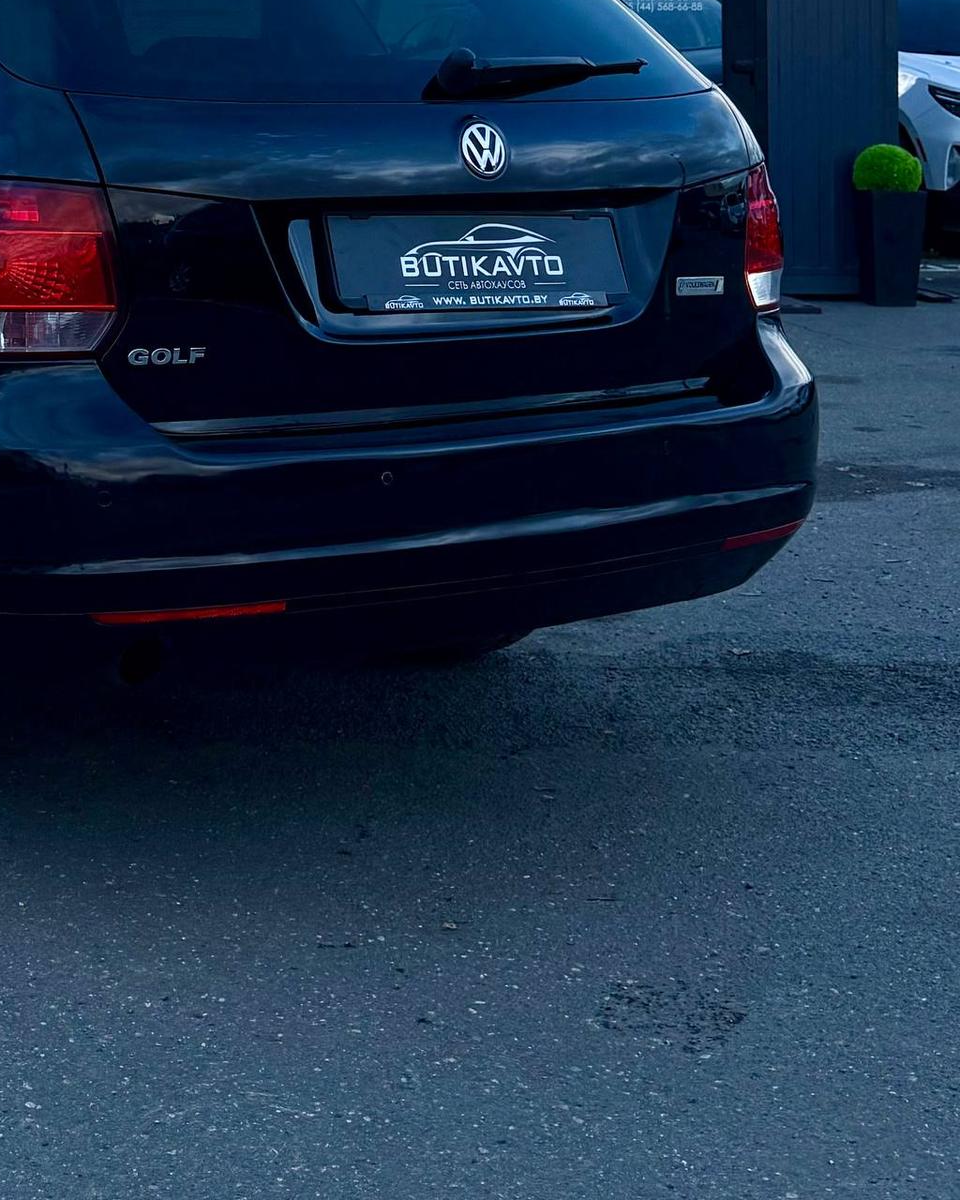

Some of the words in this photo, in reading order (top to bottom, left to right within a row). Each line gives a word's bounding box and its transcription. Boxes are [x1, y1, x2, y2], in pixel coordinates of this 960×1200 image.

[636, 1, 654, 13] (44)
[657, 1, 703, 11] 568-66-88
[400, 254, 564, 278] BUTIKAVTO
[448, 280, 469, 290] СЕТЬ
[470, 279, 527, 290] АВТОХАУСОВ
[127, 346, 207, 366] GOLF
